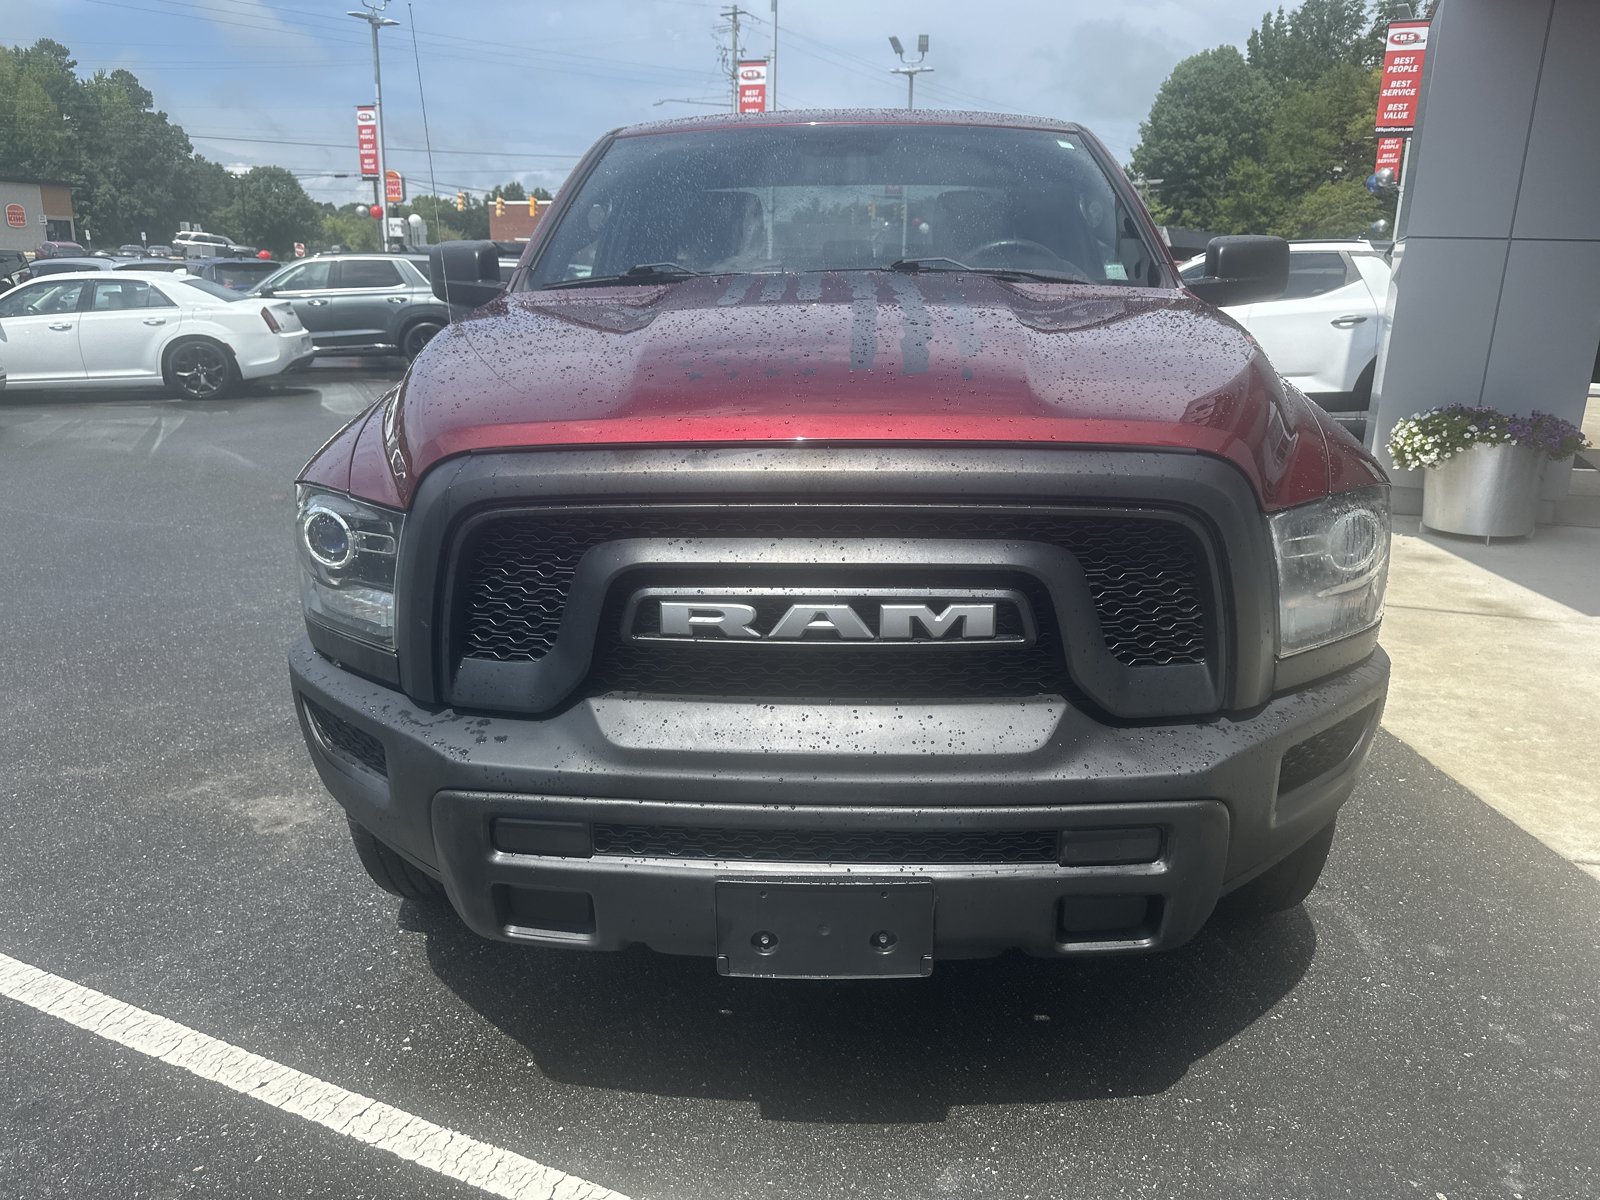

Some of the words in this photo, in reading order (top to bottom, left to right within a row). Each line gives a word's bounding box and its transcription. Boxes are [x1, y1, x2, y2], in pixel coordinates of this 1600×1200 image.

[1393, 33, 1415, 41] CBS
[1393, 56, 1416, 64] BEST
[1386, 64, 1419, 73] PEOPLE
[1390, 79, 1412, 88] BEST
[1381, 88, 1417, 97] SERVICE
[1386, 103, 1409, 111] BEST
[1383, 111, 1409, 120] VALUE
[387, 187, 401, 196] ING
[659, 600, 997, 640] RAM
